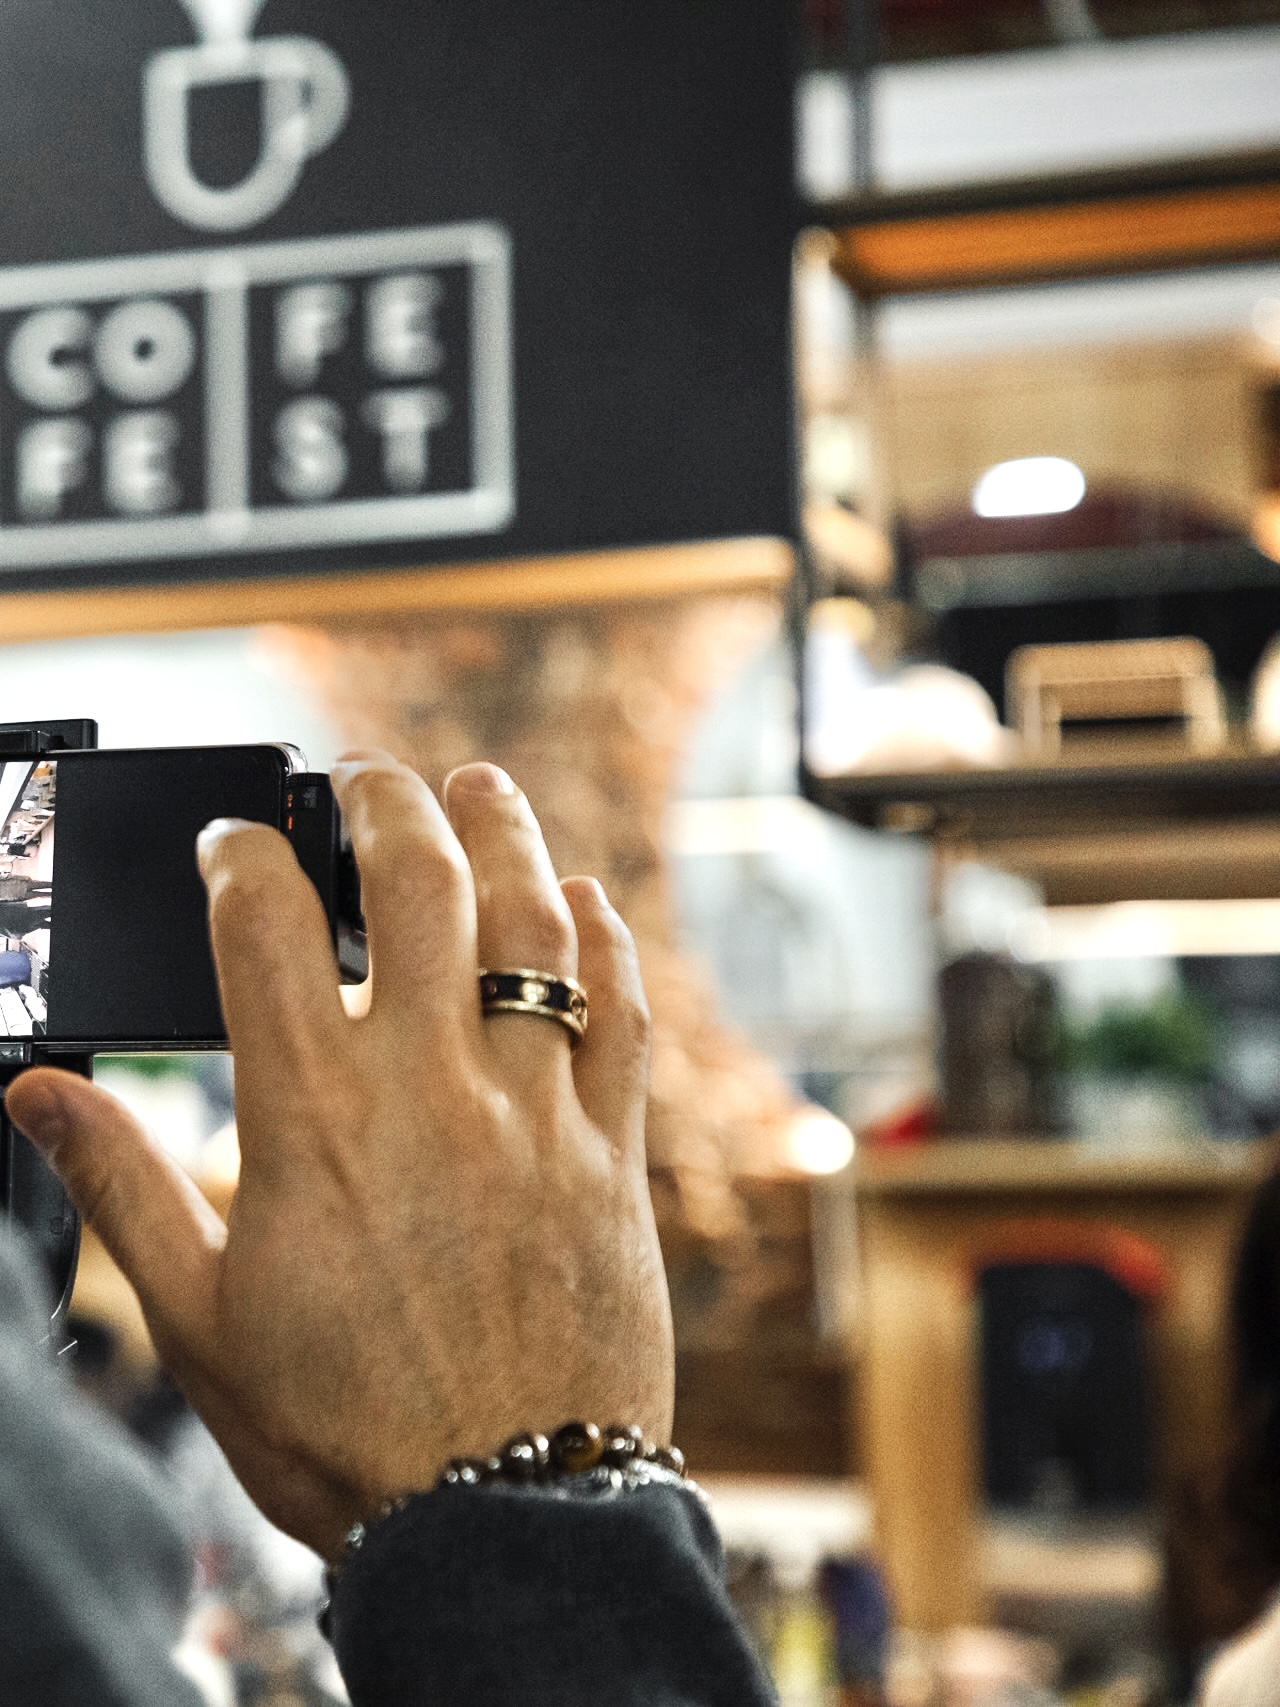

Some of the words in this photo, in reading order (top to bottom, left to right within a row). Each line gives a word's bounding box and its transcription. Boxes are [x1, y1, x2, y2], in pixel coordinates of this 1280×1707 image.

[7, 300, 196, 410] CO
[275, 273, 445, 387] FE
[19, 413, 181, 518] FE
[271, 386, 452, 500] ST
